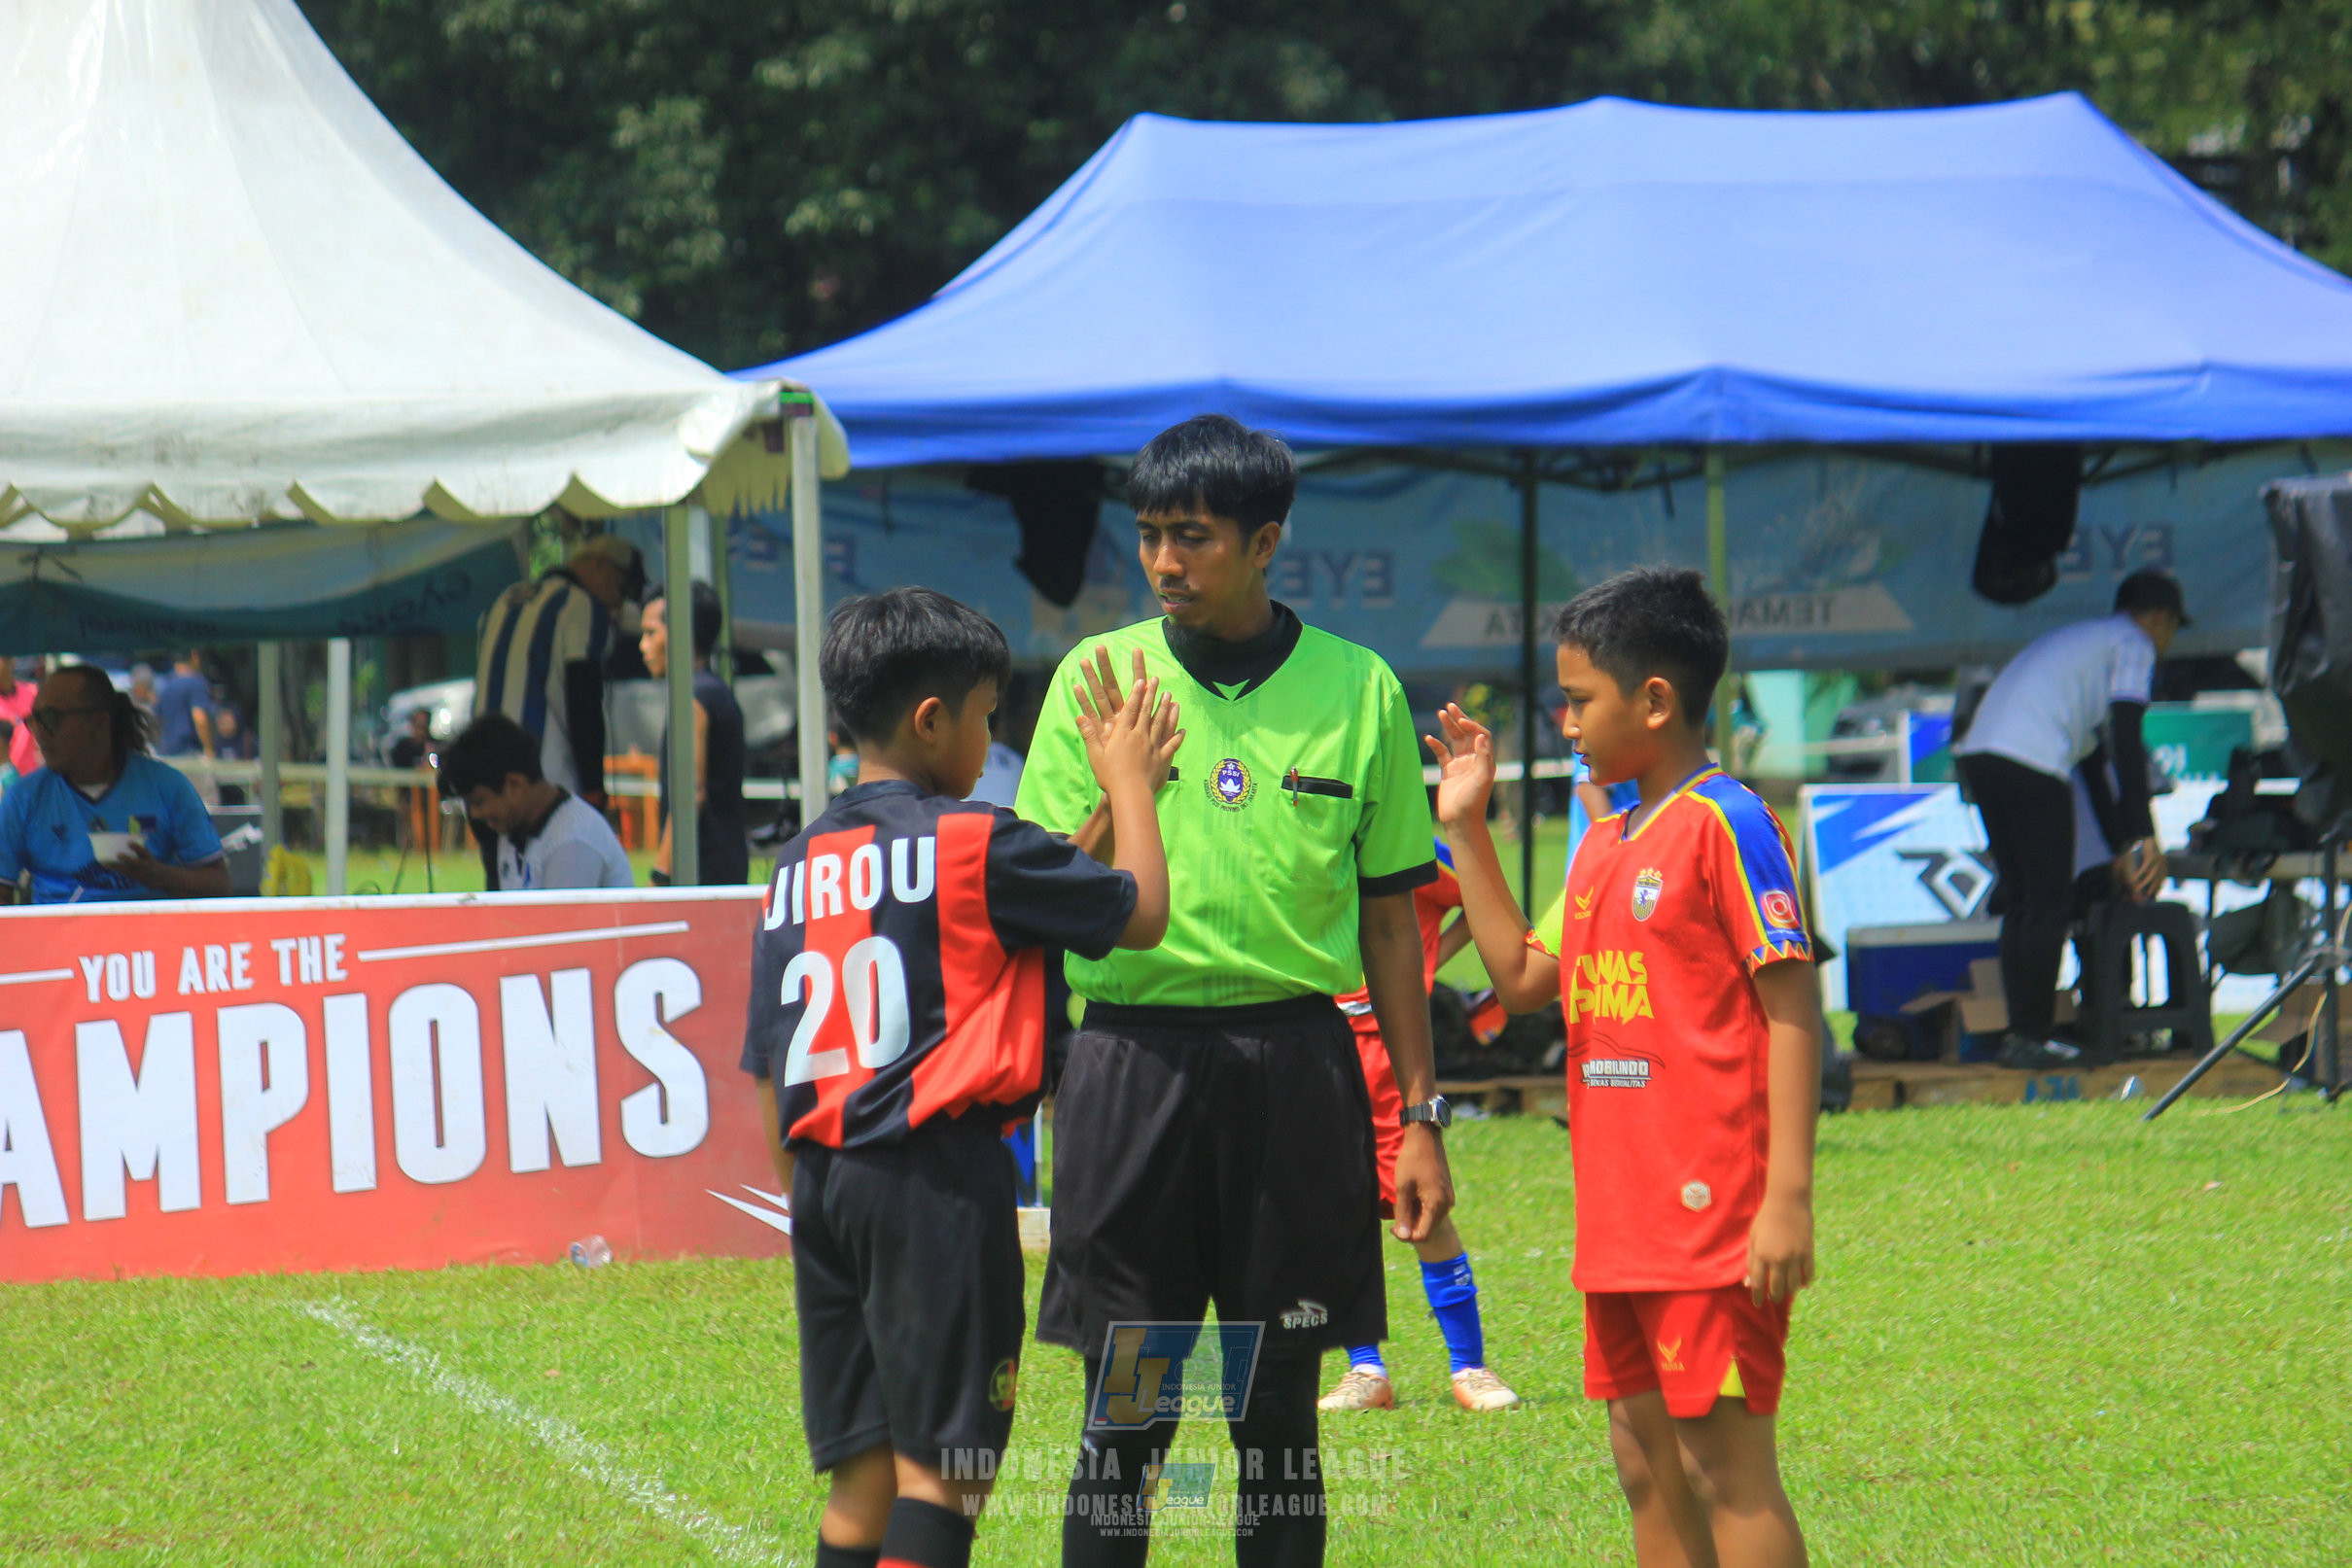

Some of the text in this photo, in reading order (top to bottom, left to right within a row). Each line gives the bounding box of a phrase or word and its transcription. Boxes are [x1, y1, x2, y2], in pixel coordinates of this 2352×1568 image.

[764, 836, 935, 930] JIROU
[79, 933, 348, 1003] YOU ARE THE
[781, 936, 910, 1088] 20
[1283, 1312, 1328, 1329] SPECS
